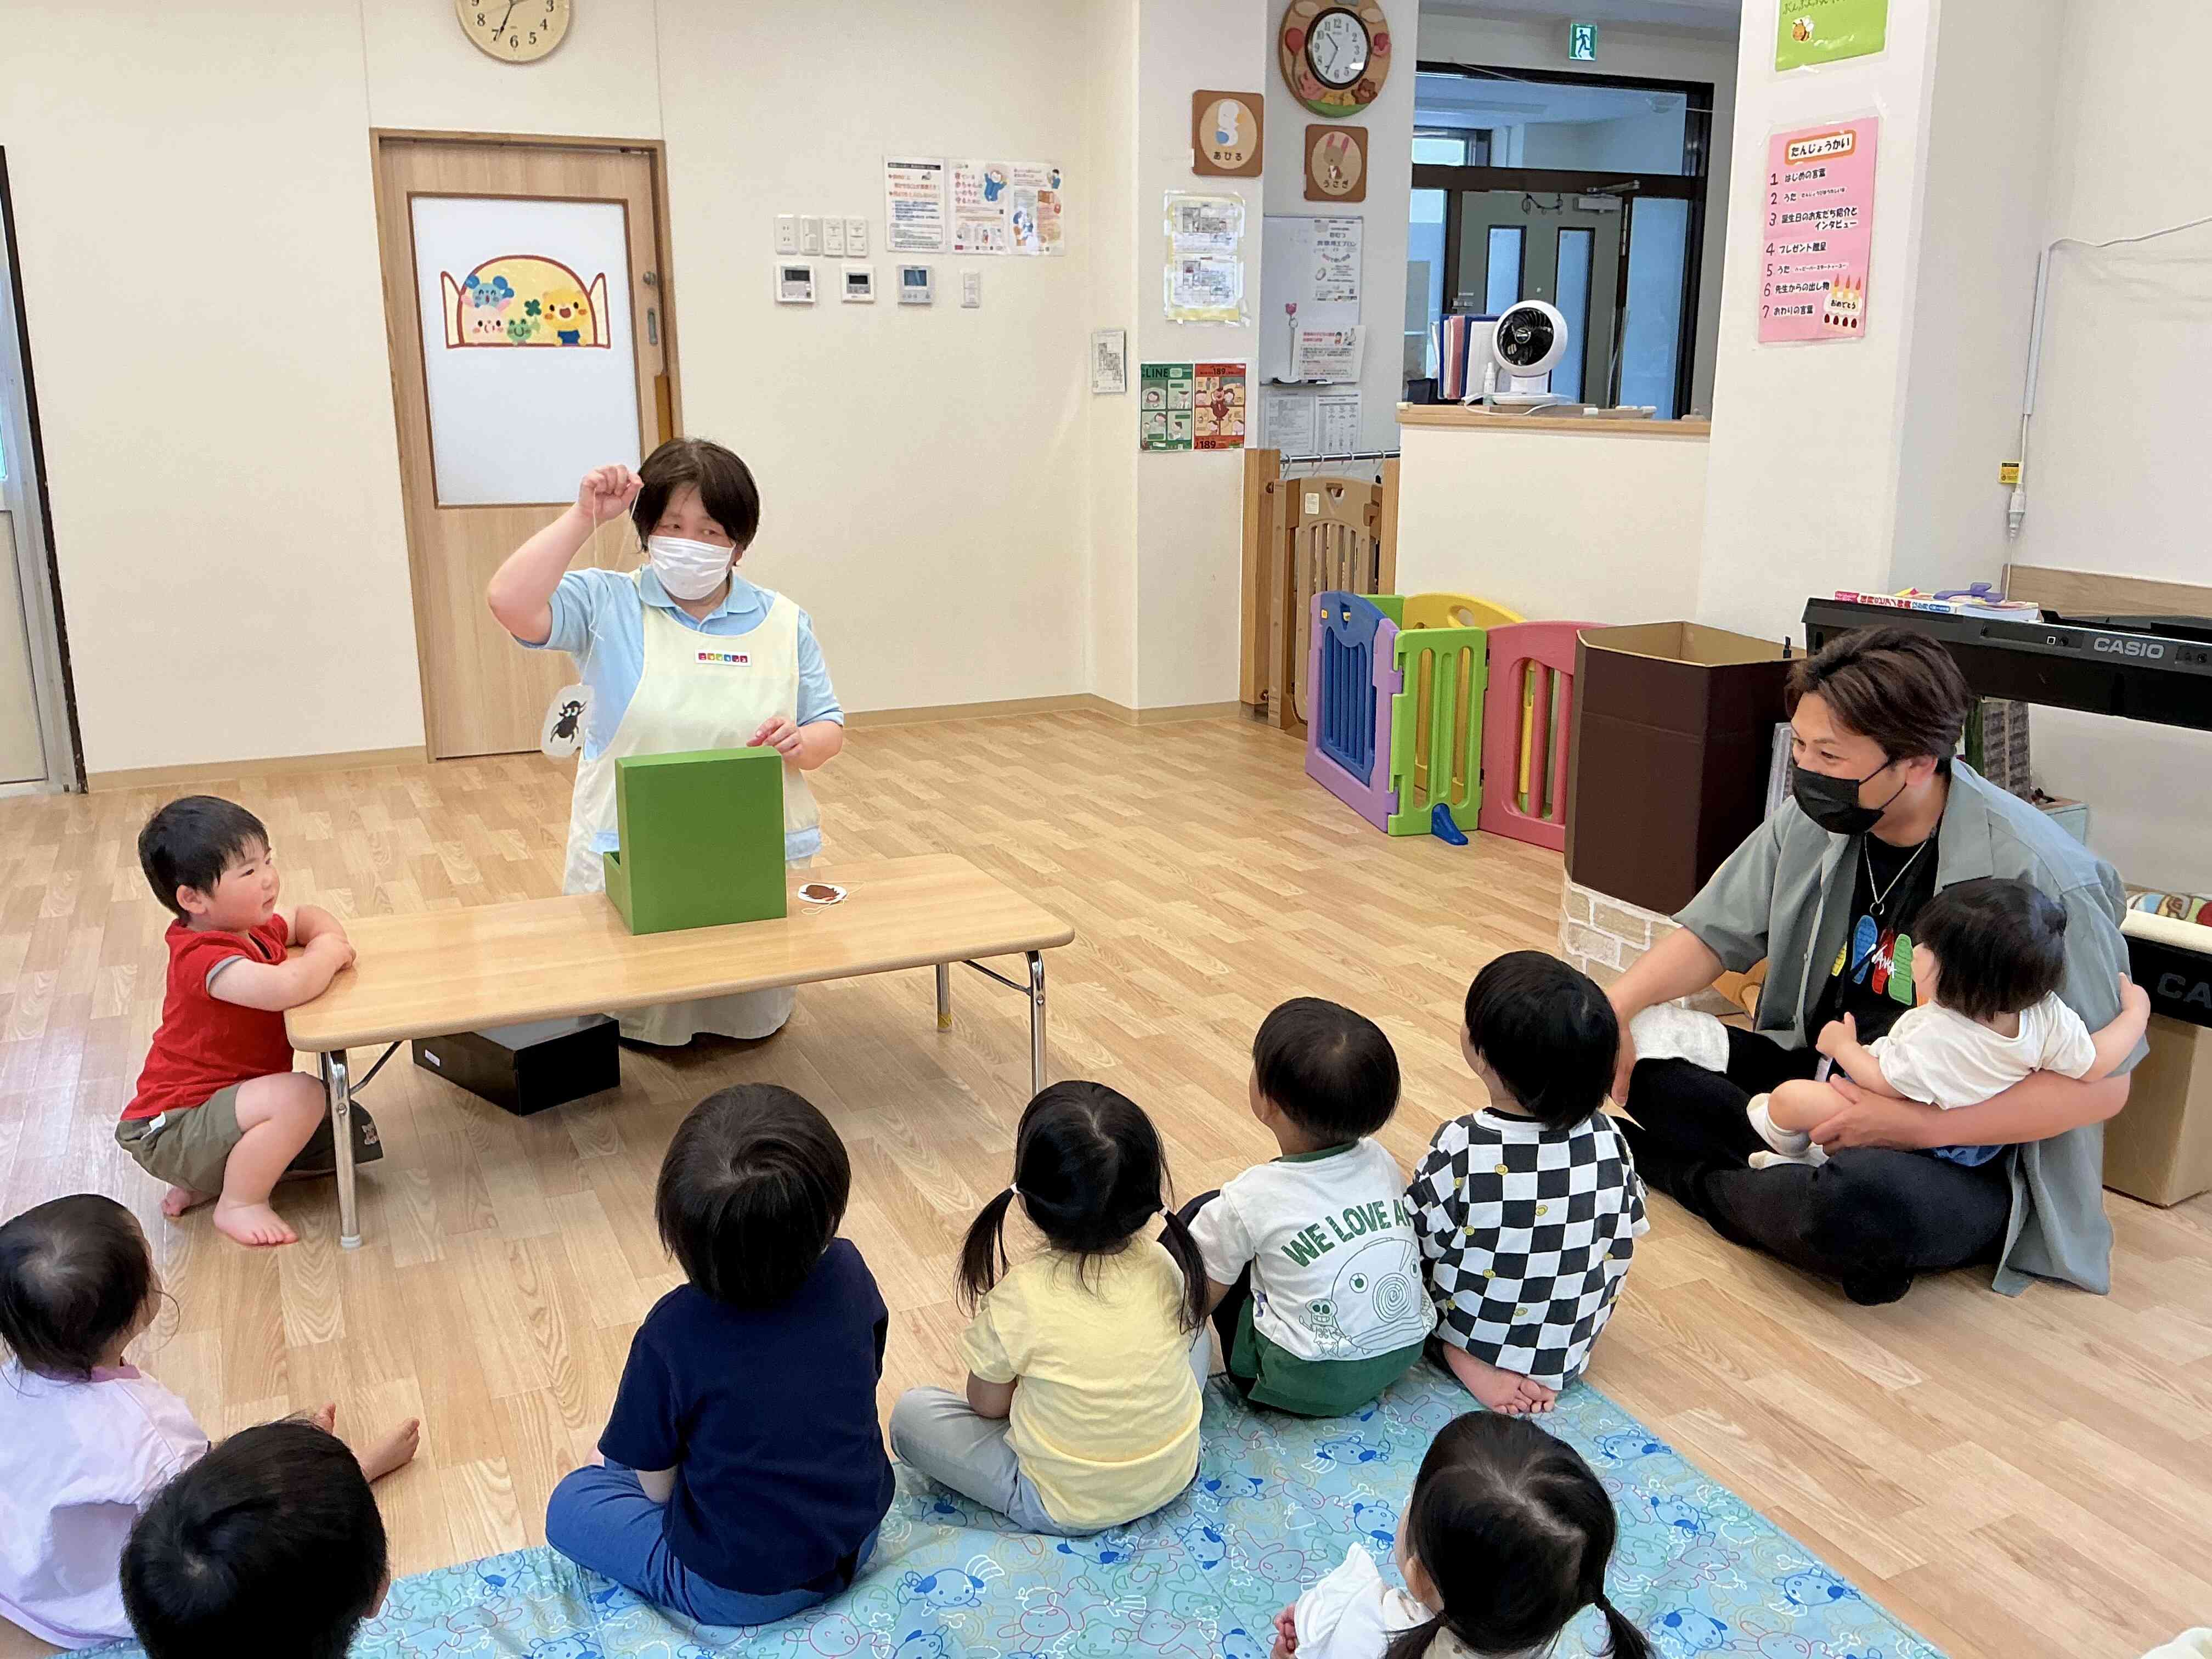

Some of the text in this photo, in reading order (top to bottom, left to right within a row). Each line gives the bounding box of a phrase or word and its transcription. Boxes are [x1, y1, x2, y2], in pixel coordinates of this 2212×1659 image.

[546, 0, 554, 12] 3
[477, 13, 486, 26] 8
[540, 19, 548, 30] 4
[1346, 22, 1349, 32] 1
[492, 29, 499, 41] 7
[528, 32, 537, 44] 5
[1352, 32, 1357, 42] 2
[510, 35, 518, 48] 6
[1314, 43, 1320, 53] 9
[1354, 45, 1359, 55] 3
[1317, 55, 1322, 65] 8
[1334, 70, 1339, 80] 6
[1791, 137, 1850, 157] たんじょうかい
[1214, 151, 1242, 161] あひる
[1770, 168, 1826, 185] 1 はじめの言葉
[1323, 179, 1348, 189] うさぎ
[1770, 192, 1778, 205] 2
[1784, 193, 1797, 202] うた
[1769, 207, 1858, 226] 3 誕生日のお友だち紹介と
[1815, 220, 1857, 231] インタビュー
[1765, 242, 1775, 256] 4
[1767, 263, 1773, 277] 5
[1778, 266, 1790, 274] うた
[1764, 281, 1830, 297] 6 先生からの出し物
[1830, 299, 1857, 309] おめでとう
[1762, 305, 1814, 319] 7 おわりの言葉
[1200, 441, 1216, 449] 189
[2094, 637, 2164, 659] CASIO
[2157, 972, 2212, 1009] CA
[1281, 1223, 1335, 1267] WE
[1325, 1200, 1392, 1243] LOVE
